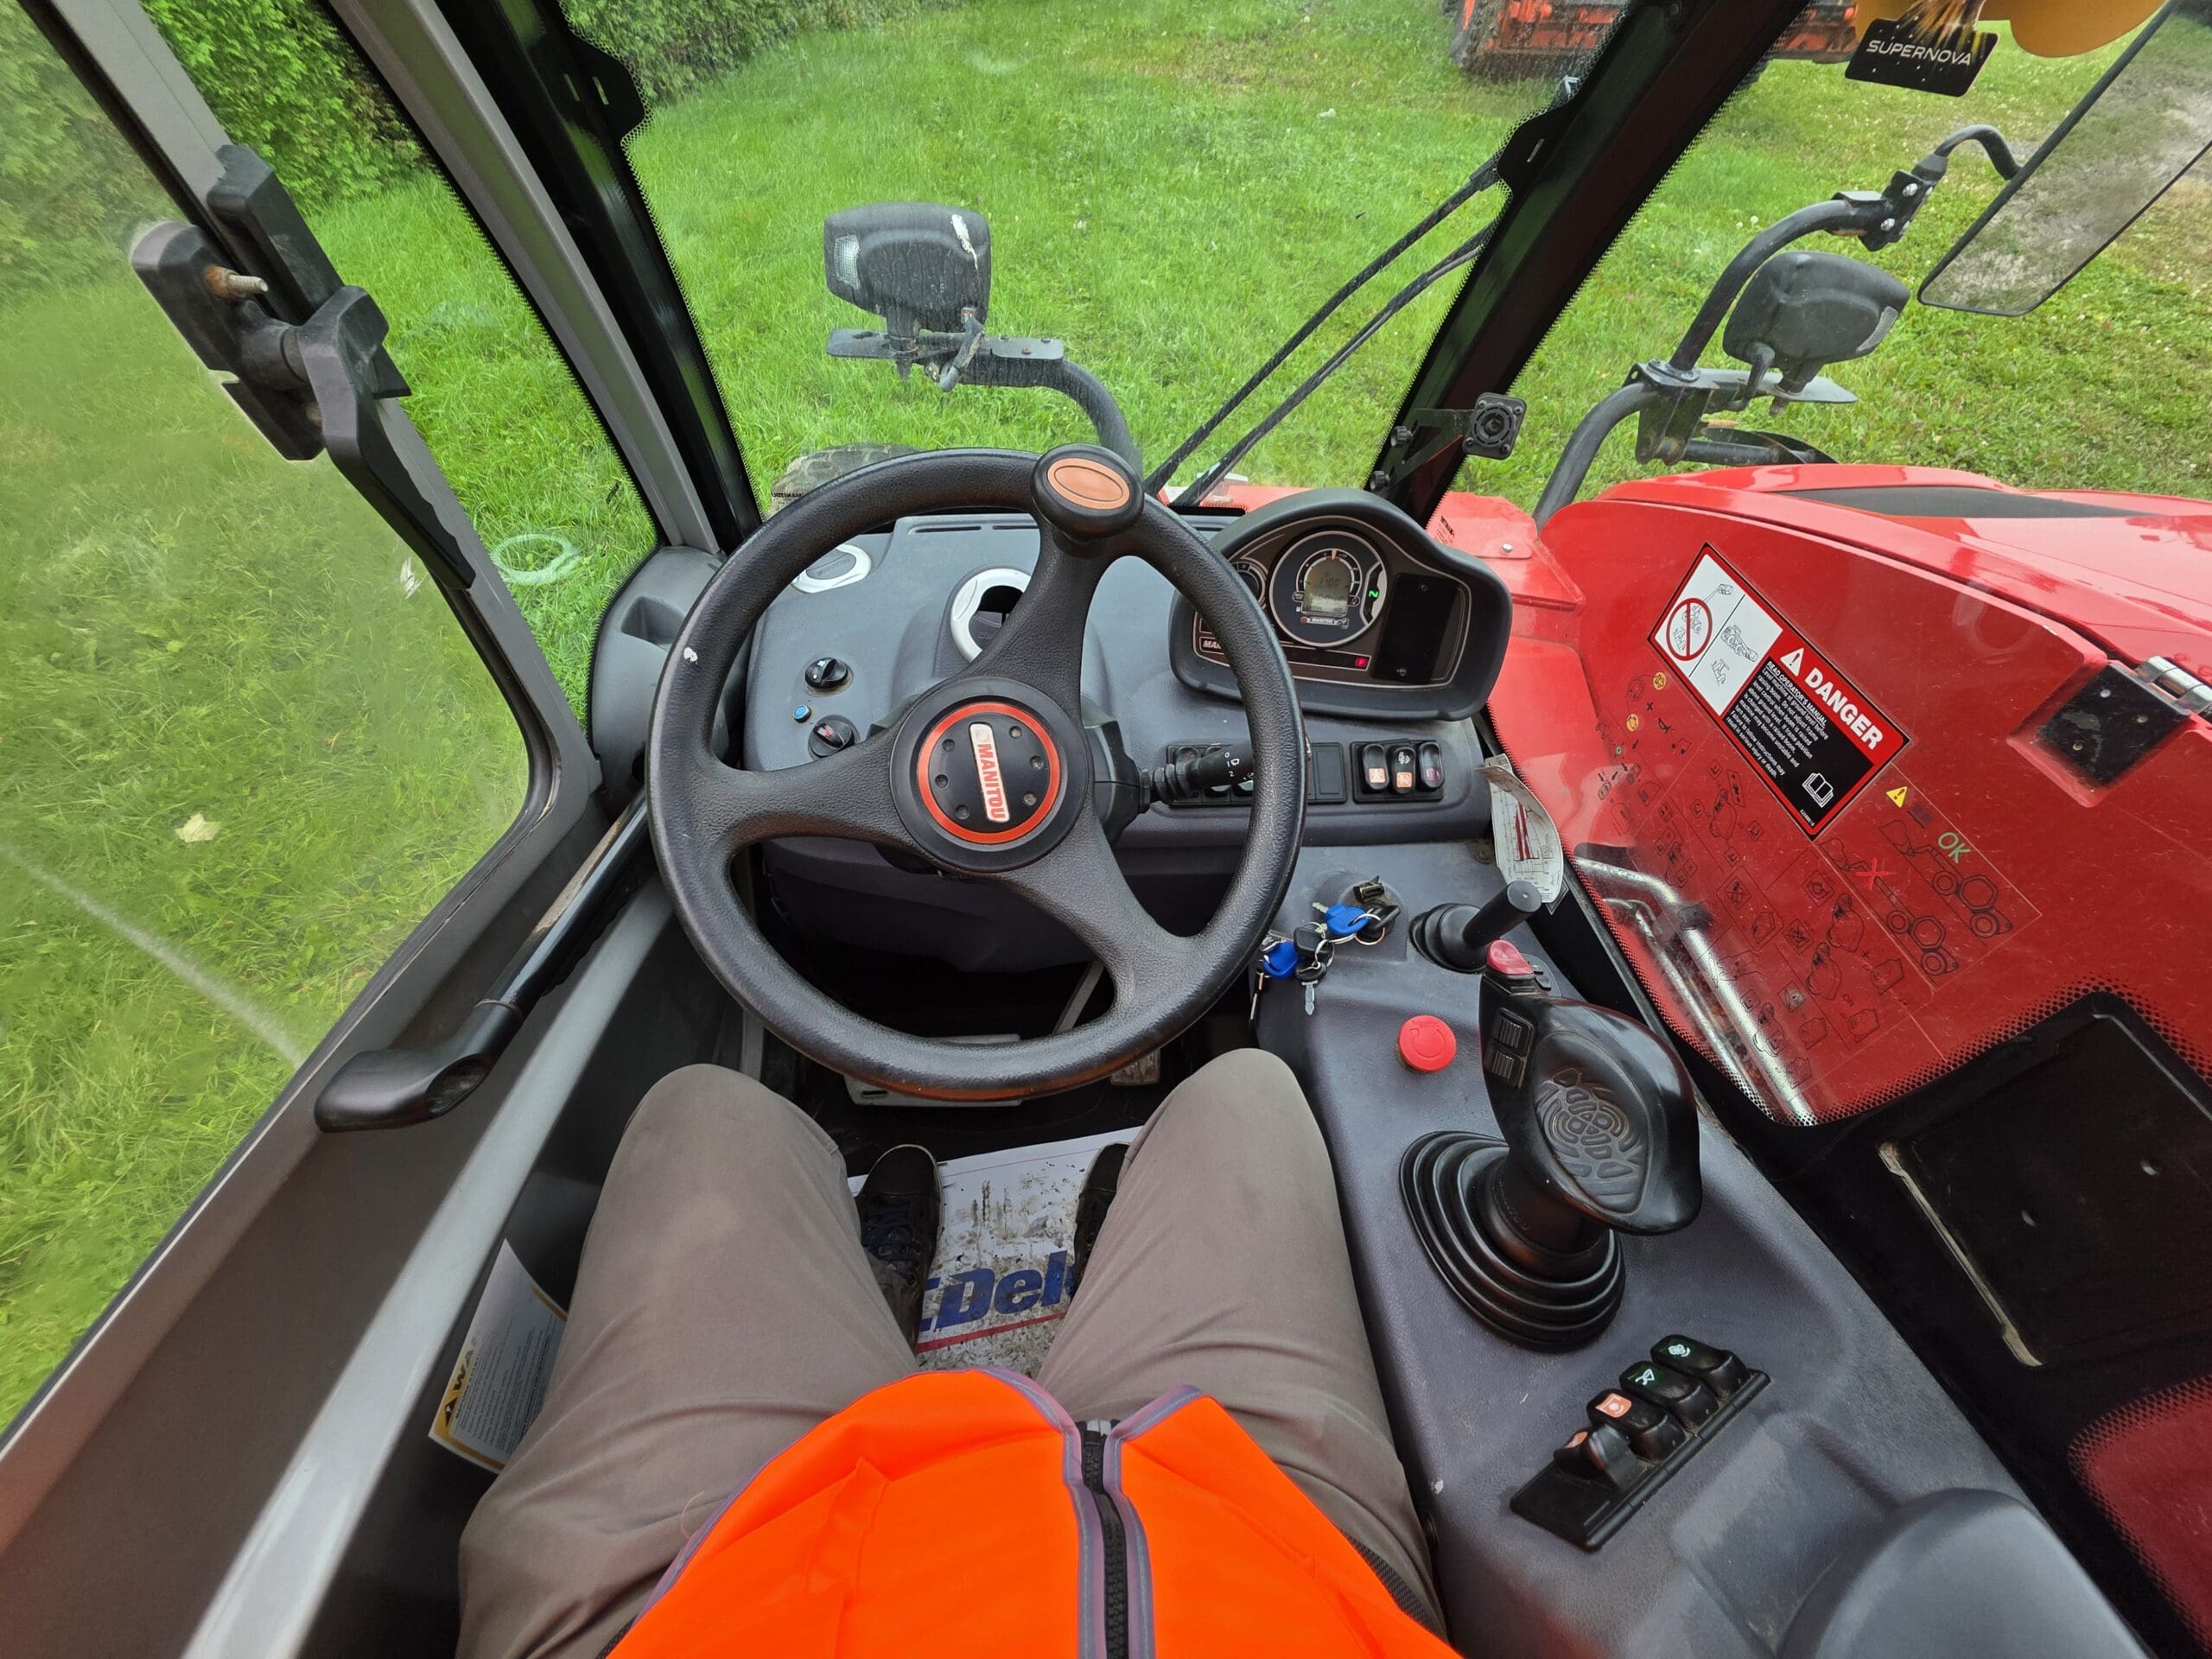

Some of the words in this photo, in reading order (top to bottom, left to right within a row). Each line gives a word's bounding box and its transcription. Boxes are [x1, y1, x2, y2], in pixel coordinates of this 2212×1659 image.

[1866, 40, 1972, 67] SUPERNOVA
[1734, 704, 1743, 715] turn
[1742, 713, 1751, 724] over.
[1746, 696, 1763, 715] changed
[1761, 713, 1770, 724] with
[1772, 725, 1785, 740] raised
[1748, 686, 1760, 701] above
[1758, 697, 1772, 715] ground
[1770, 711, 1782, 724] level.
[1784, 727, 1797, 742] frame
[1795, 739, 1813, 760] position
[1752, 680, 1763, 692] level
[1761, 690, 1775, 705] control
[1773, 702, 1785, 716] when
[1783, 714, 1796, 728] boom
[1797, 729, 1812, 746] raised
[1757, 674, 1770, 690] raising
[1769, 687, 1783, 702] boom.
[1781, 700, 1789, 709] Do
[1787, 706, 1796, 715] not
[1793, 713, 1807, 729] adjust
[1805, 726, 1819, 741] frame
[1762, 668, 1773, 680] Level
[1771, 677, 1788, 696] machine
[1789, 699, 1806, 716] ground
[1804, 713, 1815, 726] level
[1814, 723, 1829, 740] before
[1766, 660, 1780, 676] READ
[1778, 673, 1808, 704] OPERATOR'S
[1806, 702, 1827, 725] MANUAL
[1804, 667, 1885, 749] DANGER
[1726, 715, 1737, 729] result
[1739, 731, 1752, 747] serious
[1751, 746, 1762, 760] injury
[1764, 762, 1777, 778] death.
[1730, 710, 1743, 726] Failure
[1745, 728, 1758, 742] follow
[1756, 740, 1777, 766] instructions
[1775, 763, 1785, 776] may
[1738, 698, 1754, 716] machine
[1752, 715, 1762, 726] may
[1760, 723, 1776, 741] become
[1774, 739, 1791, 759] unstable
[1789, 757, 1799, 767] and
[977, 744, 1006, 821] MANITOU
[1938, 832, 1971, 864] OK
